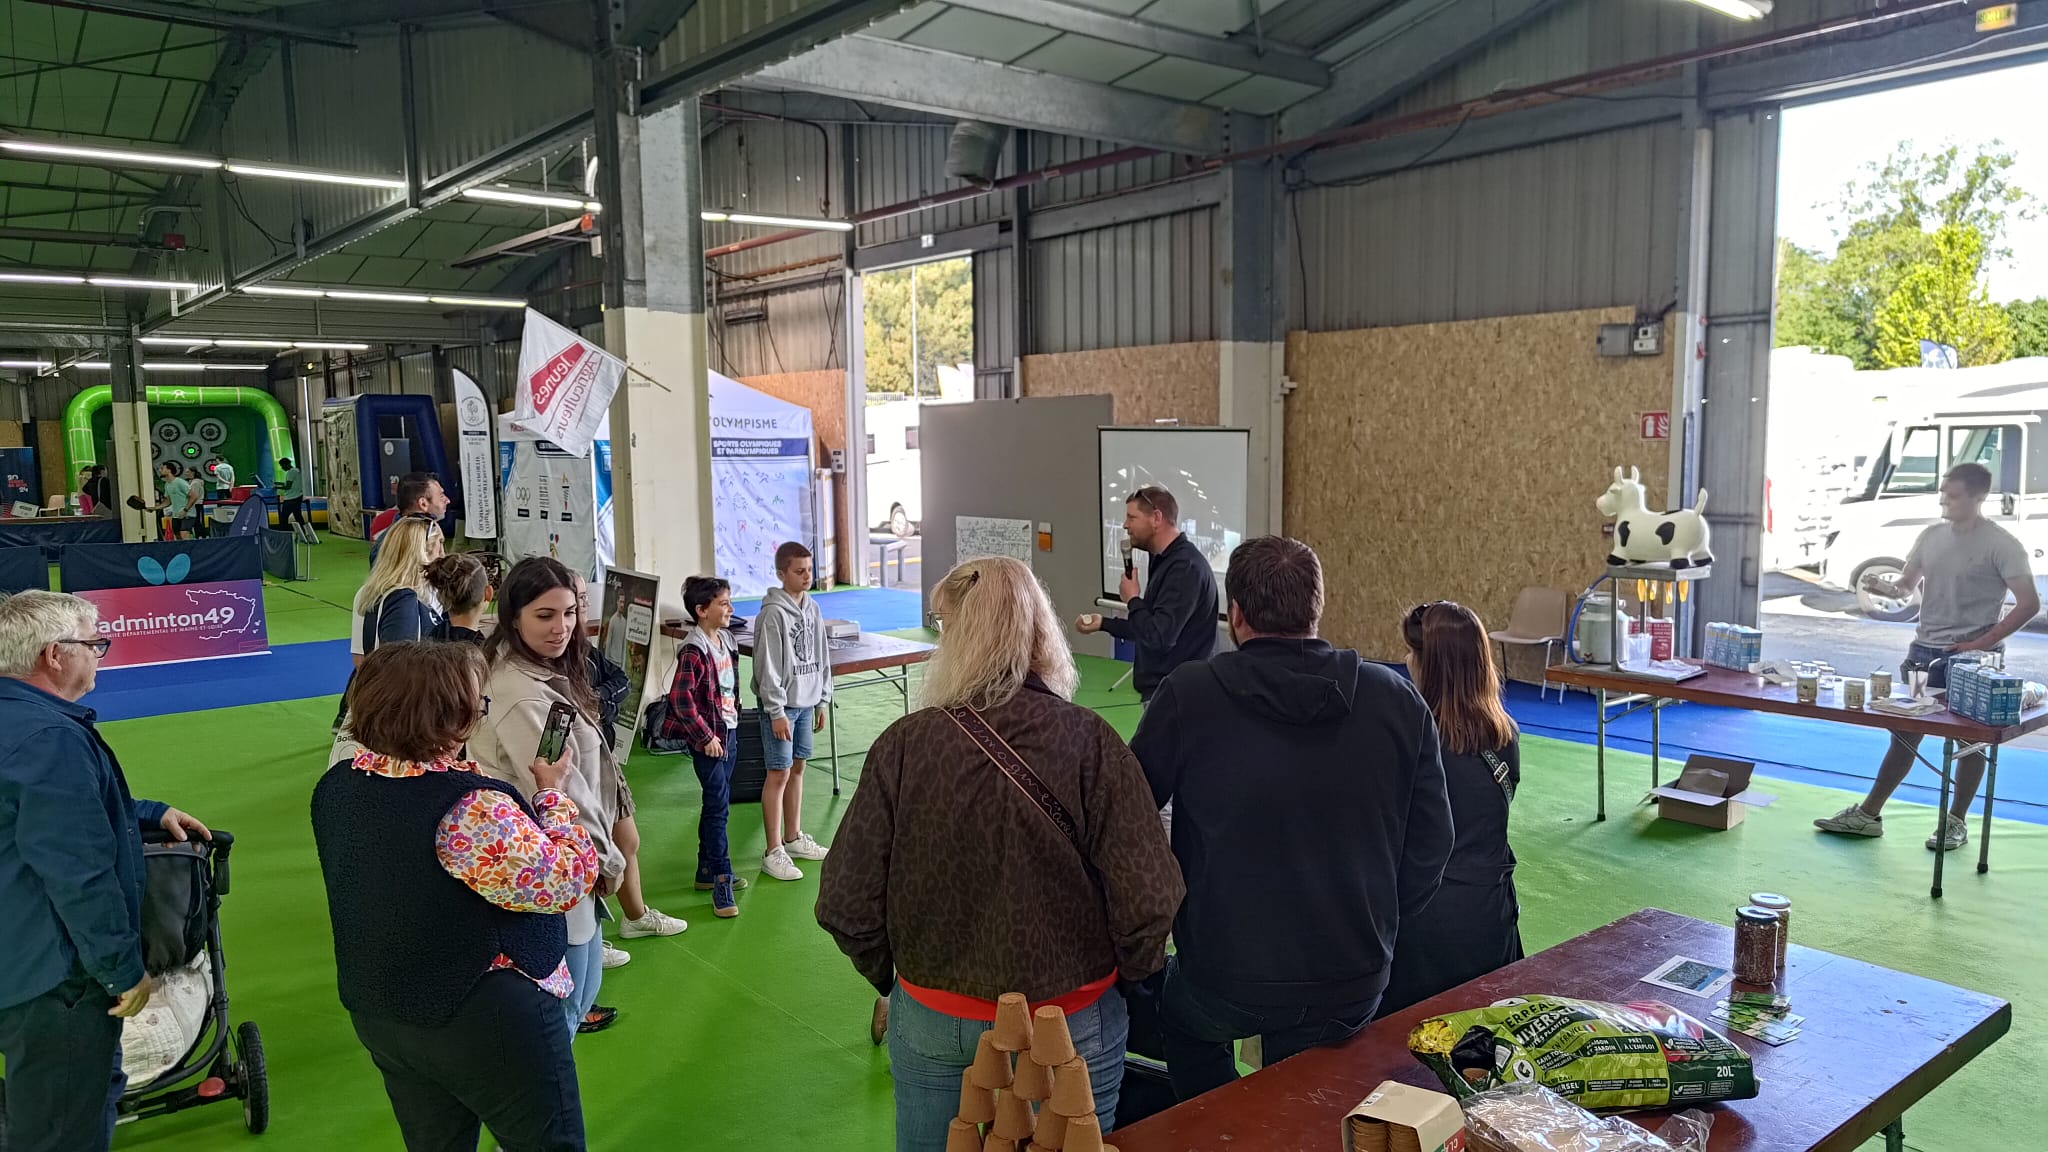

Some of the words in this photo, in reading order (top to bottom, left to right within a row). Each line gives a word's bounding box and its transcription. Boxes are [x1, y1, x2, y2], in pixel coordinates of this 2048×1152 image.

[726, 447, 779, 455] PARALYMPIQUES
[94, 606, 236, 633] adminton49
[1544, 1016, 1570, 1036] PLANTES
[1716, 1066, 1735, 1078] 20L
